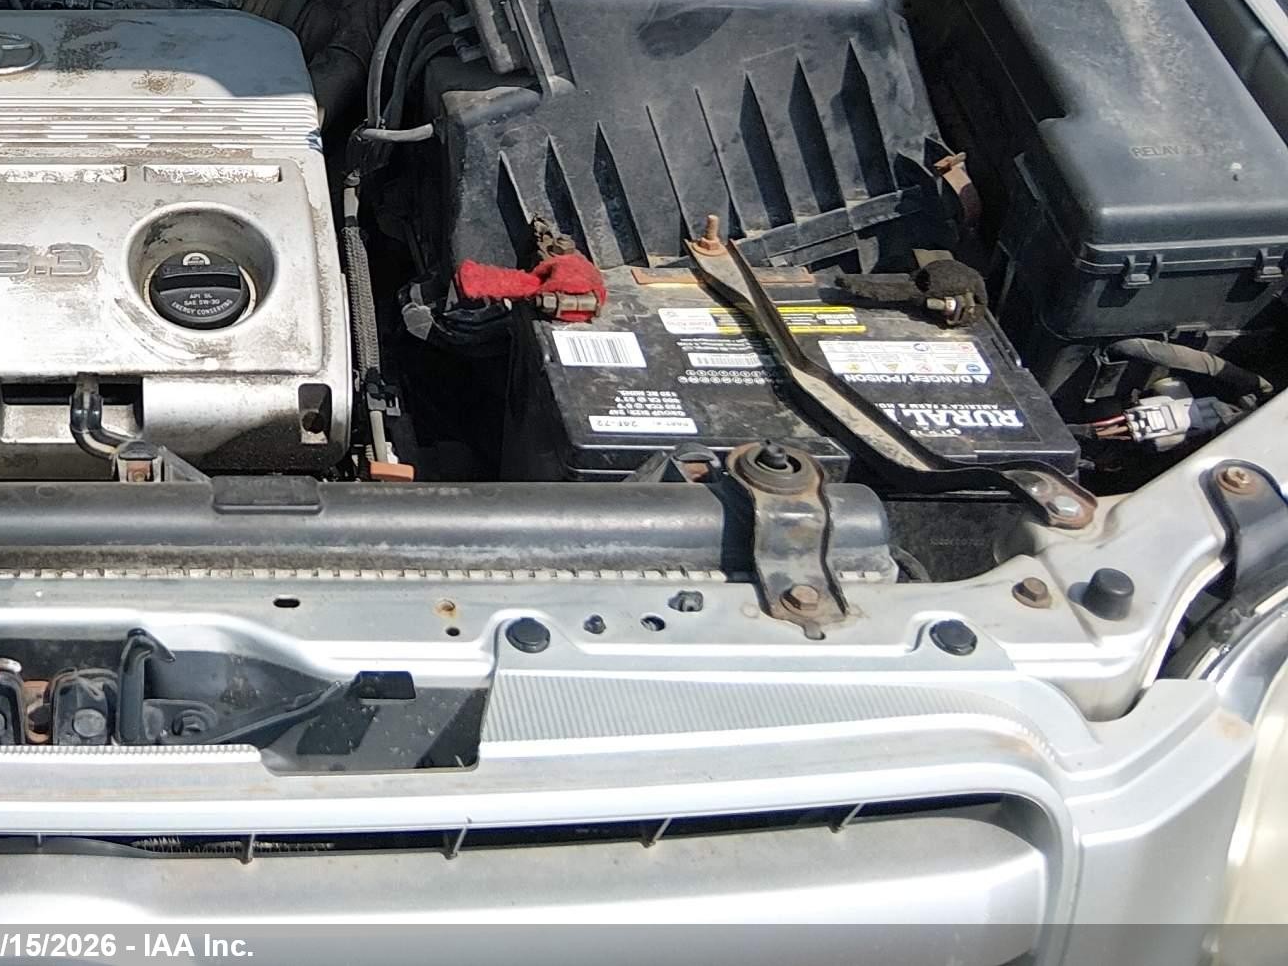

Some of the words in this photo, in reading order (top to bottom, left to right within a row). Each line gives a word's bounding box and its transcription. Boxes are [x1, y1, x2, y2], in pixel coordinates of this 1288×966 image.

[171, 301, 196, 315] ENERGY
[197, 299, 233, 315] CONSERVING
[900, 409, 1024, 427] RURAL
